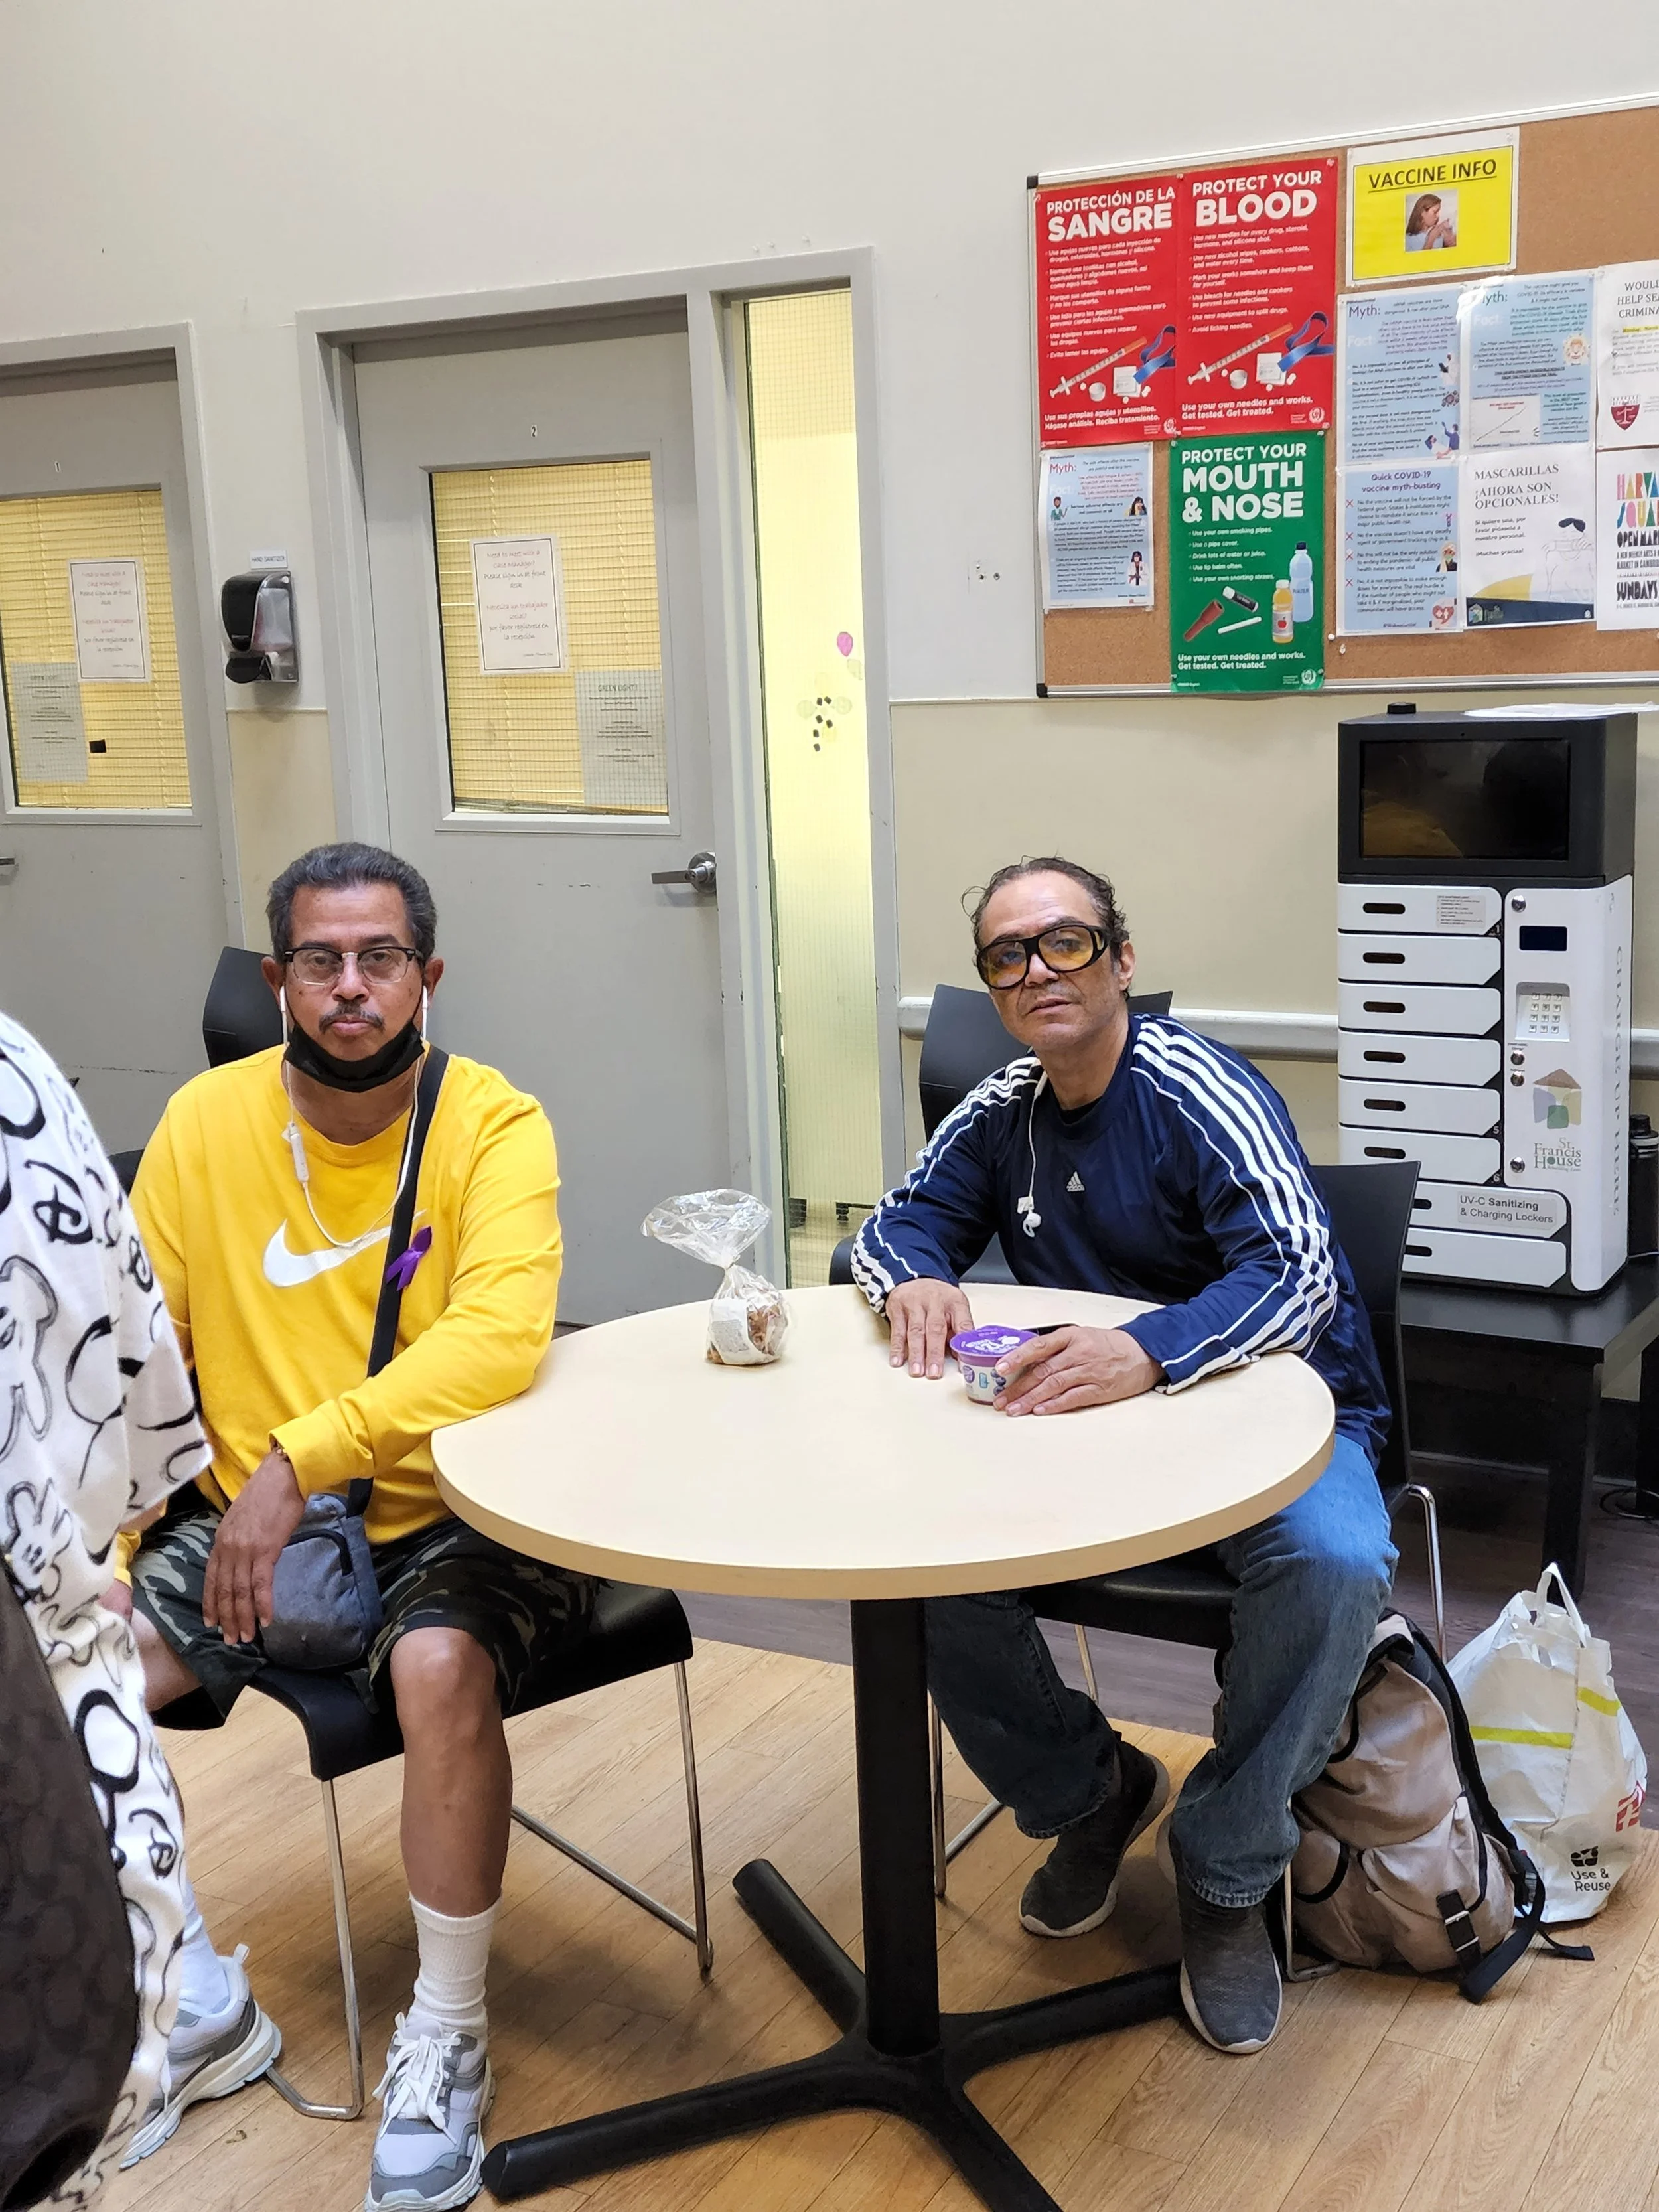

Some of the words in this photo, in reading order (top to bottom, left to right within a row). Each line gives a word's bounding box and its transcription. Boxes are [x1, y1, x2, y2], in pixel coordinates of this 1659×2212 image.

[1369, 165, 1446, 189] VACCINE
[1453, 159, 1496, 179] INFO
[1192, 175, 1268, 196] PROTECT
[1273, 170, 1321, 188] YOUR
[1046, 190, 1133, 214] PROTECCIÓN
[1137, 189, 1154, 204] DE
[1158, 187, 1175, 200] LA
[1196, 190, 1316, 226] BLOOD
[1048, 203, 1173, 242] SANGRE
[1482, 291, 1508, 306] yth:
[1617, 295, 1643, 305] HELP
[1646, 293, 1659, 303] SE
[1348, 303, 1380, 319] Myth:
[1198, 403, 1216, 413] your
[1236, 399, 1267, 407] needles
[1269, 396, 1284, 405] and
[1286, 395, 1313, 404] works.
[1198, 410, 1224, 419] tested.
[1242, 407, 1273, 416] treated.
[1182, 446, 1255, 464] PROTECT
[1260, 443, 1307, 459] YOUR
[1050, 462, 1076, 475] Myth:
[1371, 473, 1392, 481] Quick
[1394, 470, 1431, 480] COVID-19
[1475, 463, 1559, 480] MASCARILLAS
[1183, 461, 1303, 494] MOUTH
[1362, 484, 1390, 493] vaccine
[1392, 482, 1441, 492] myth-busting
[1475, 485, 1523, 500] ¡AHORA
[1527, 482, 1552, 492] SON
[1182, 496, 1203, 523] &
[1212, 490, 1304, 521] NOSE
[1475, 493, 1559, 510] OPCIONALES!
[1617, 500, 1659, 529] SQUA
[1617, 530, 1639, 548] OPEN
[1617, 579, 1658, 601] SUNDAYS
[1493, 1126, 1500, 1134] 5
[1534, 1142, 1582, 1157] Francis
[1493, 1173, 1500, 1182] 6
[1460, 1195, 1486, 1205] UV-C
[1488, 1197, 1539, 1211] Sanitizing
[1460, 1207, 1467, 1216] &
[1470, 1208, 1513, 1221] Charging
[1516, 1213, 1553, 1223] Lockers
[1571, 1870, 1597, 1880] Use
[1600, 1868, 1609, 1878] &
[1574, 1881, 1611, 1892] Reuse
